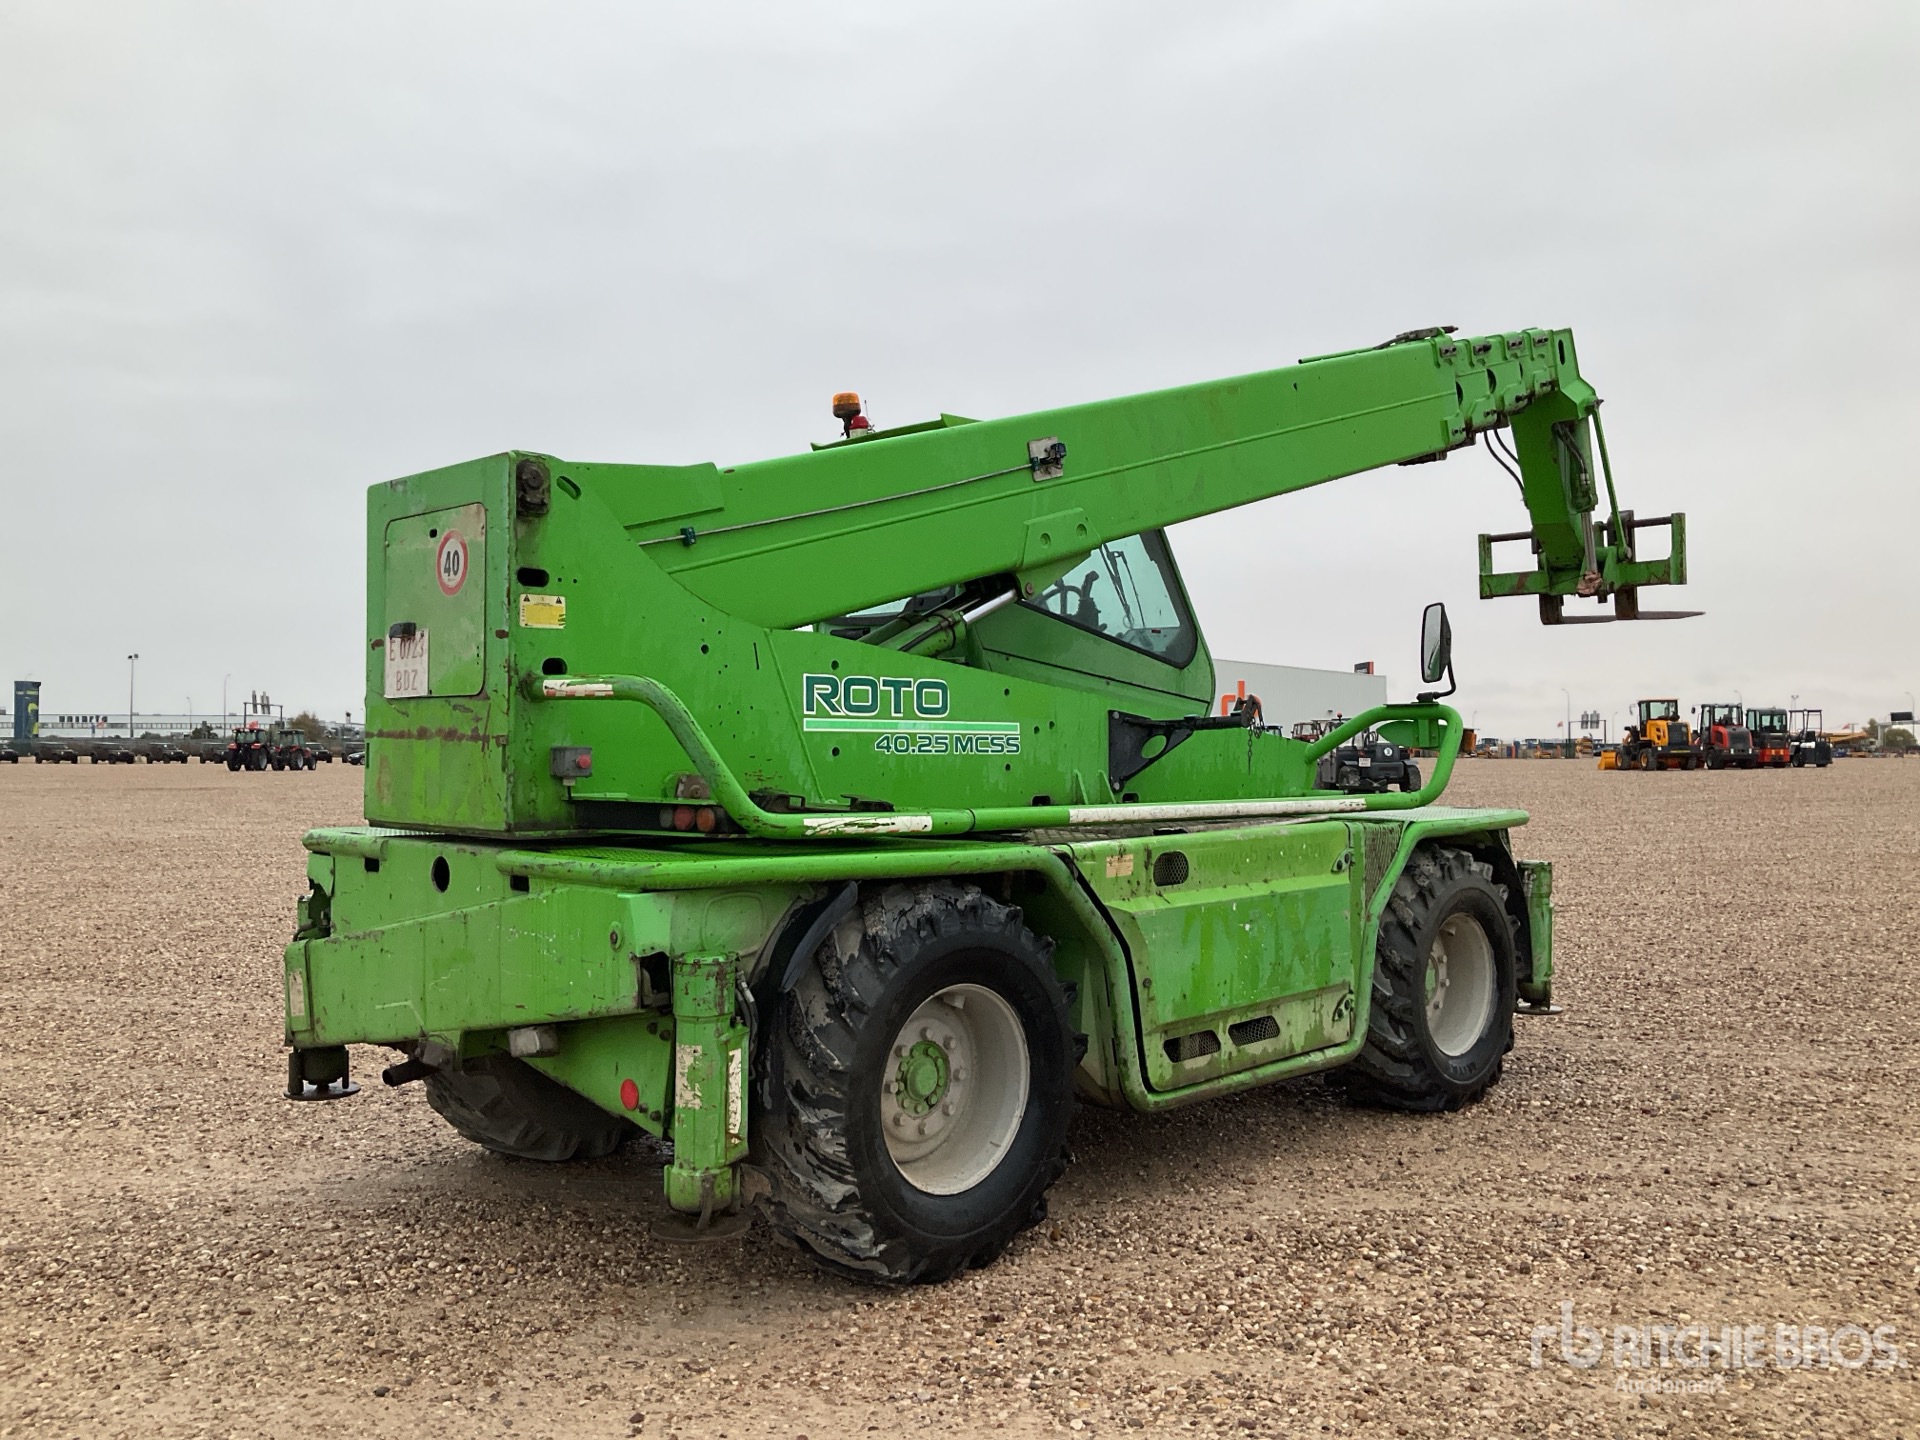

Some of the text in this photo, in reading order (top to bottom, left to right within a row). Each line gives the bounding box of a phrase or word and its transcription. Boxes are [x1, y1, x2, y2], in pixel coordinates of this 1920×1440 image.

[443, 549, 460, 577] 40
[389, 638, 396, 661] E
[396, 669, 418, 691] BDZ
[803, 673, 950, 718] ROTO
[874, 734, 1021, 755] 40.25 MCSS
